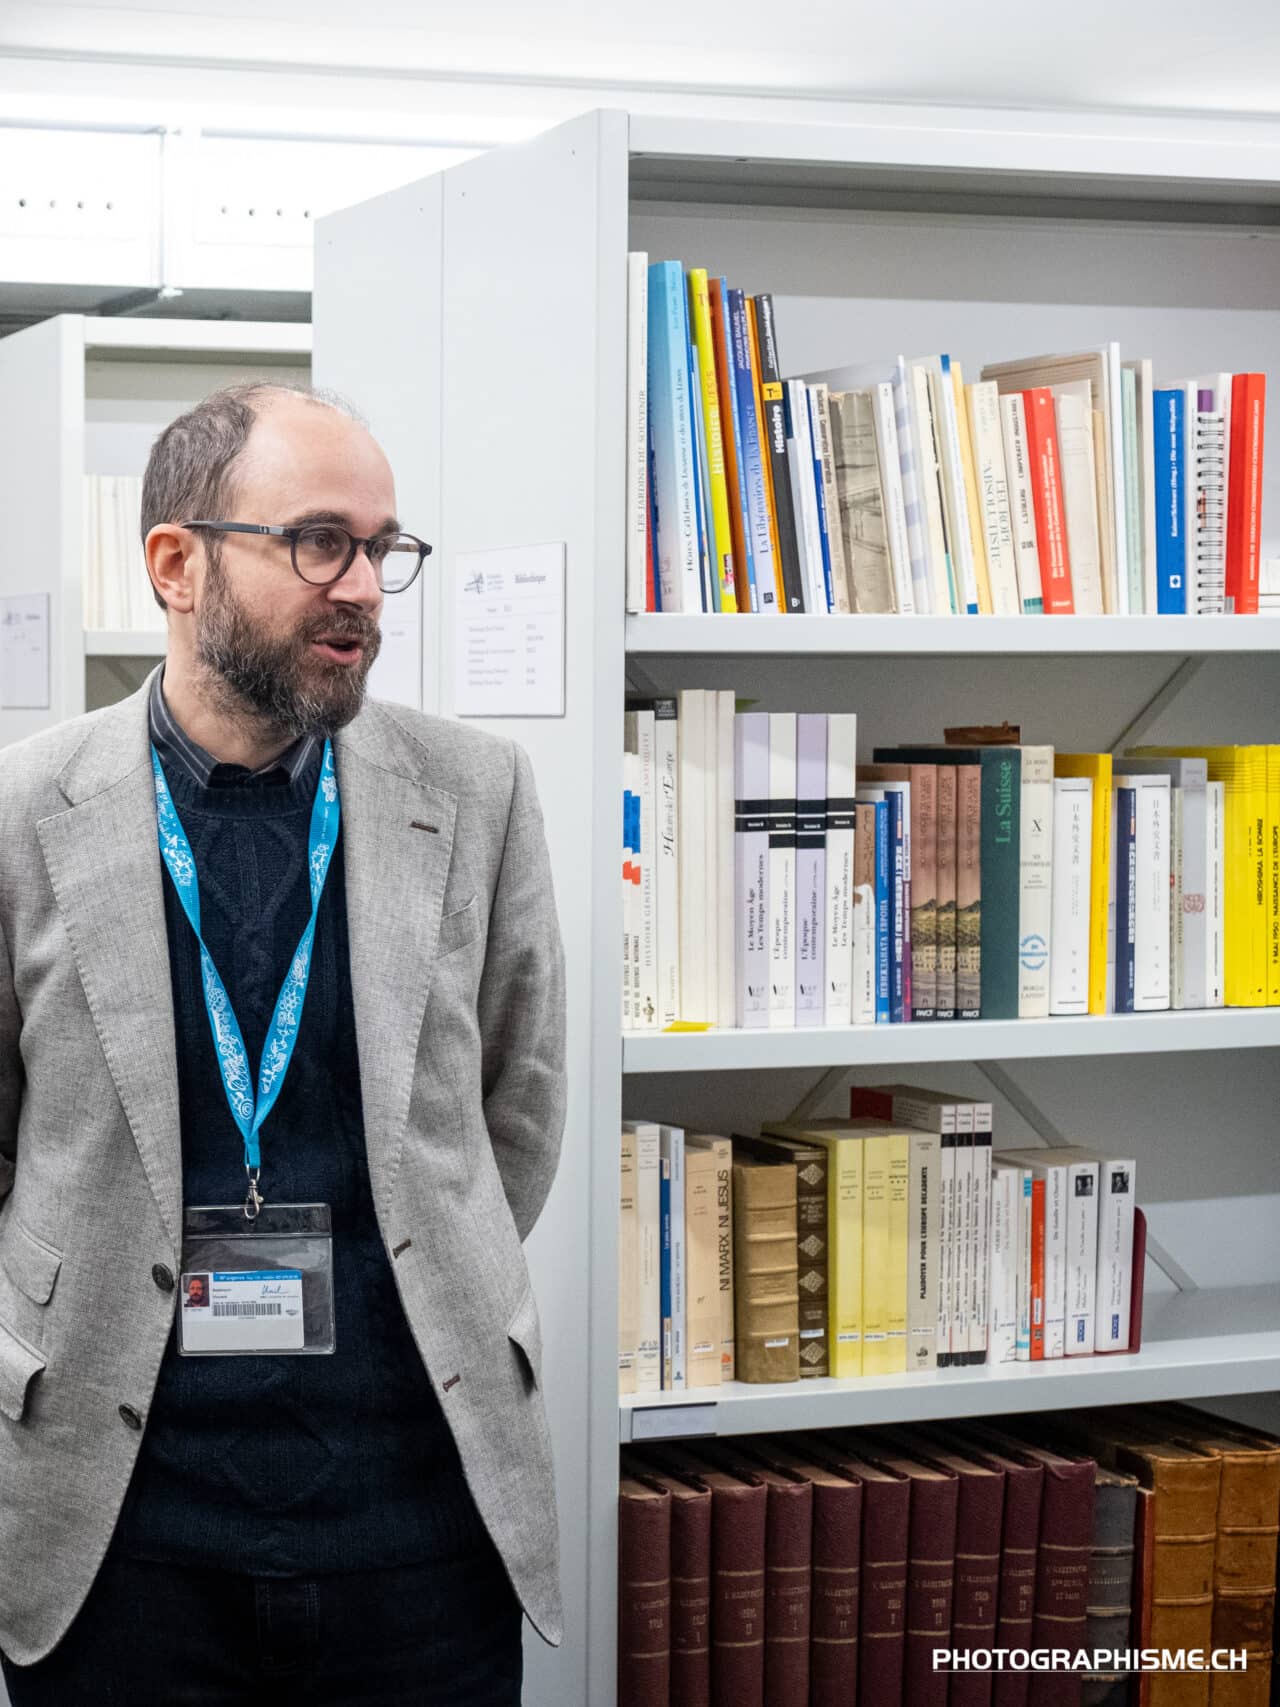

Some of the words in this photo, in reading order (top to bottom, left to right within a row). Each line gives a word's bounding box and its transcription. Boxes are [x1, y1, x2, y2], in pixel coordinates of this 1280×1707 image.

[774, 406, 784, 453] Histoire
[638, 447, 645, 463] DU
[637, 513, 645, 532] LES
[995, 761, 1011, 816] Suisse
[995, 820, 1011, 843] La
[1273, 861, 1279, 871] DE
[832, 904, 840, 934] Moyen
[841, 900, 849, 929] Temps
[748, 941, 754, 951] Le
[717, 1169, 730, 1211] JESUS
[718, 1215, 730, 1229] NI
[718, 1233, 730, 1277] MARX
[719, 1279, 730, 1291] NI
